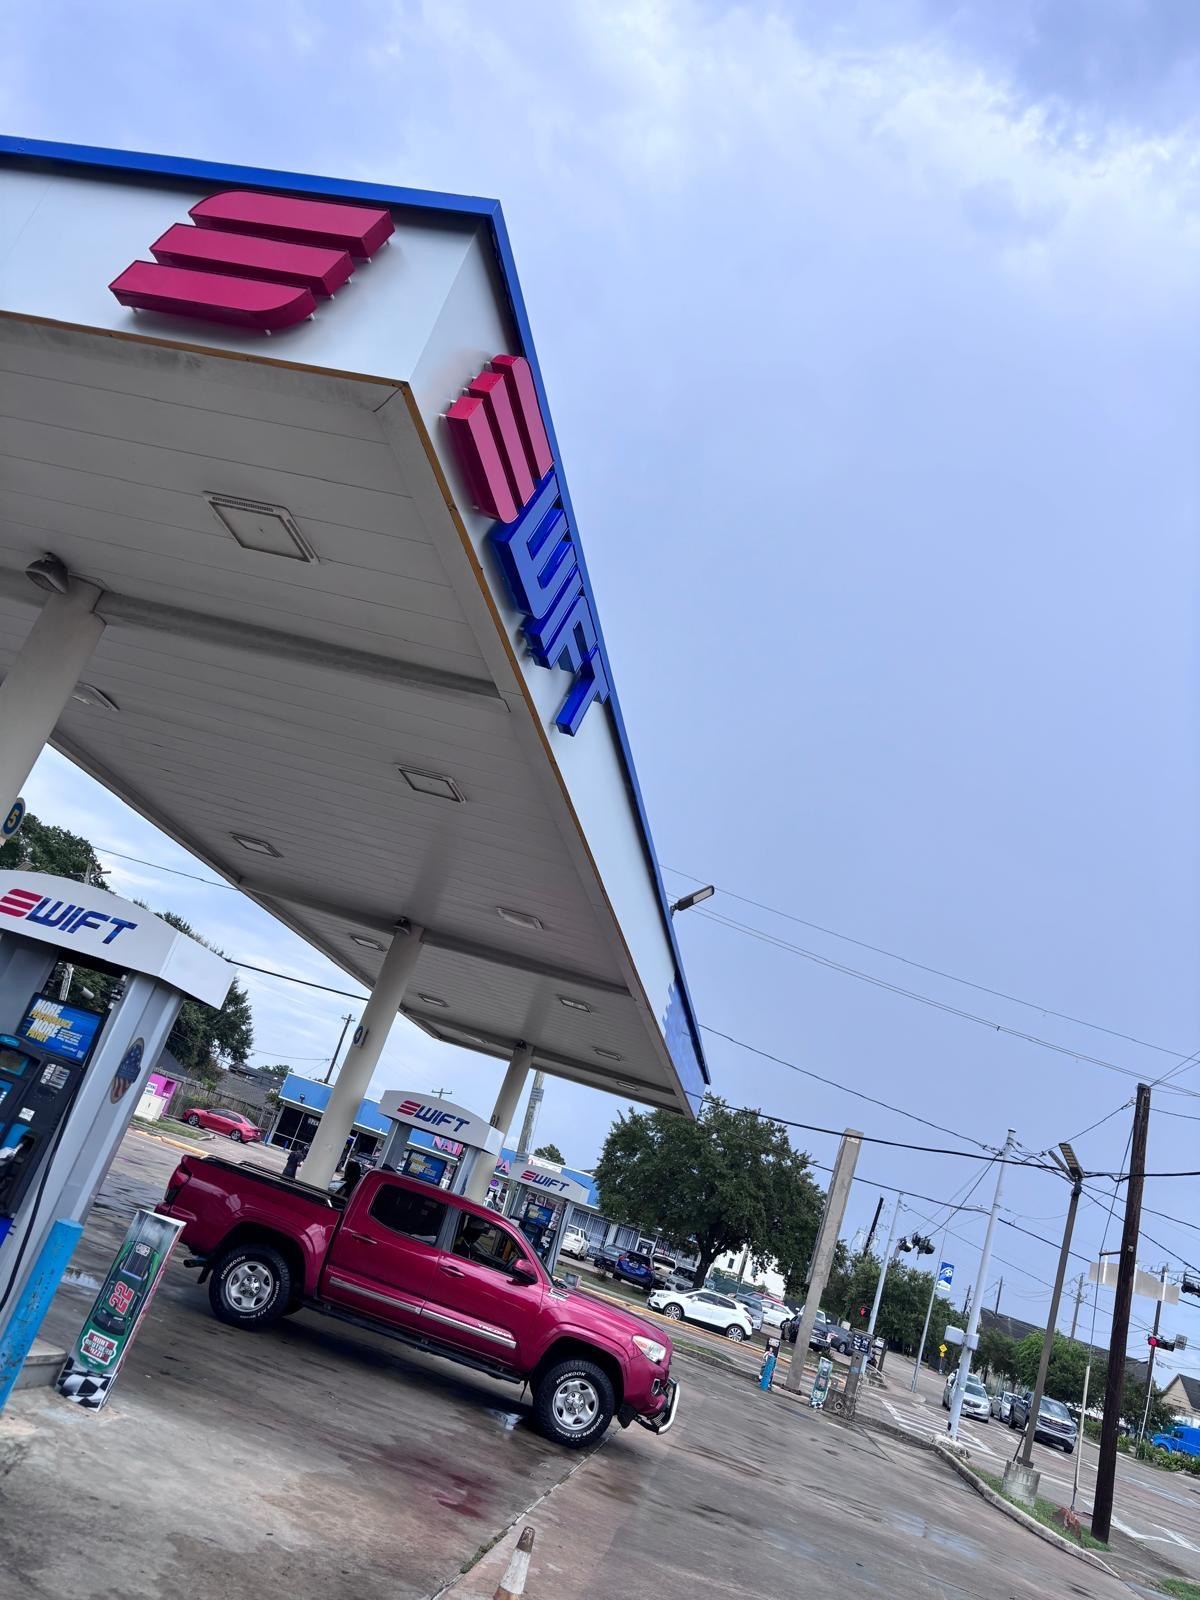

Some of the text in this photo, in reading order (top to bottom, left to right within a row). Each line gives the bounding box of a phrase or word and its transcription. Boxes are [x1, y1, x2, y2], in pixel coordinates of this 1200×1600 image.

[7, 808, 20, 828] 5
[34, 998, 64, 1018] MORE
[31, 1018, 62, 1039] MORE
[108, 1281, 135, 1316] 22
